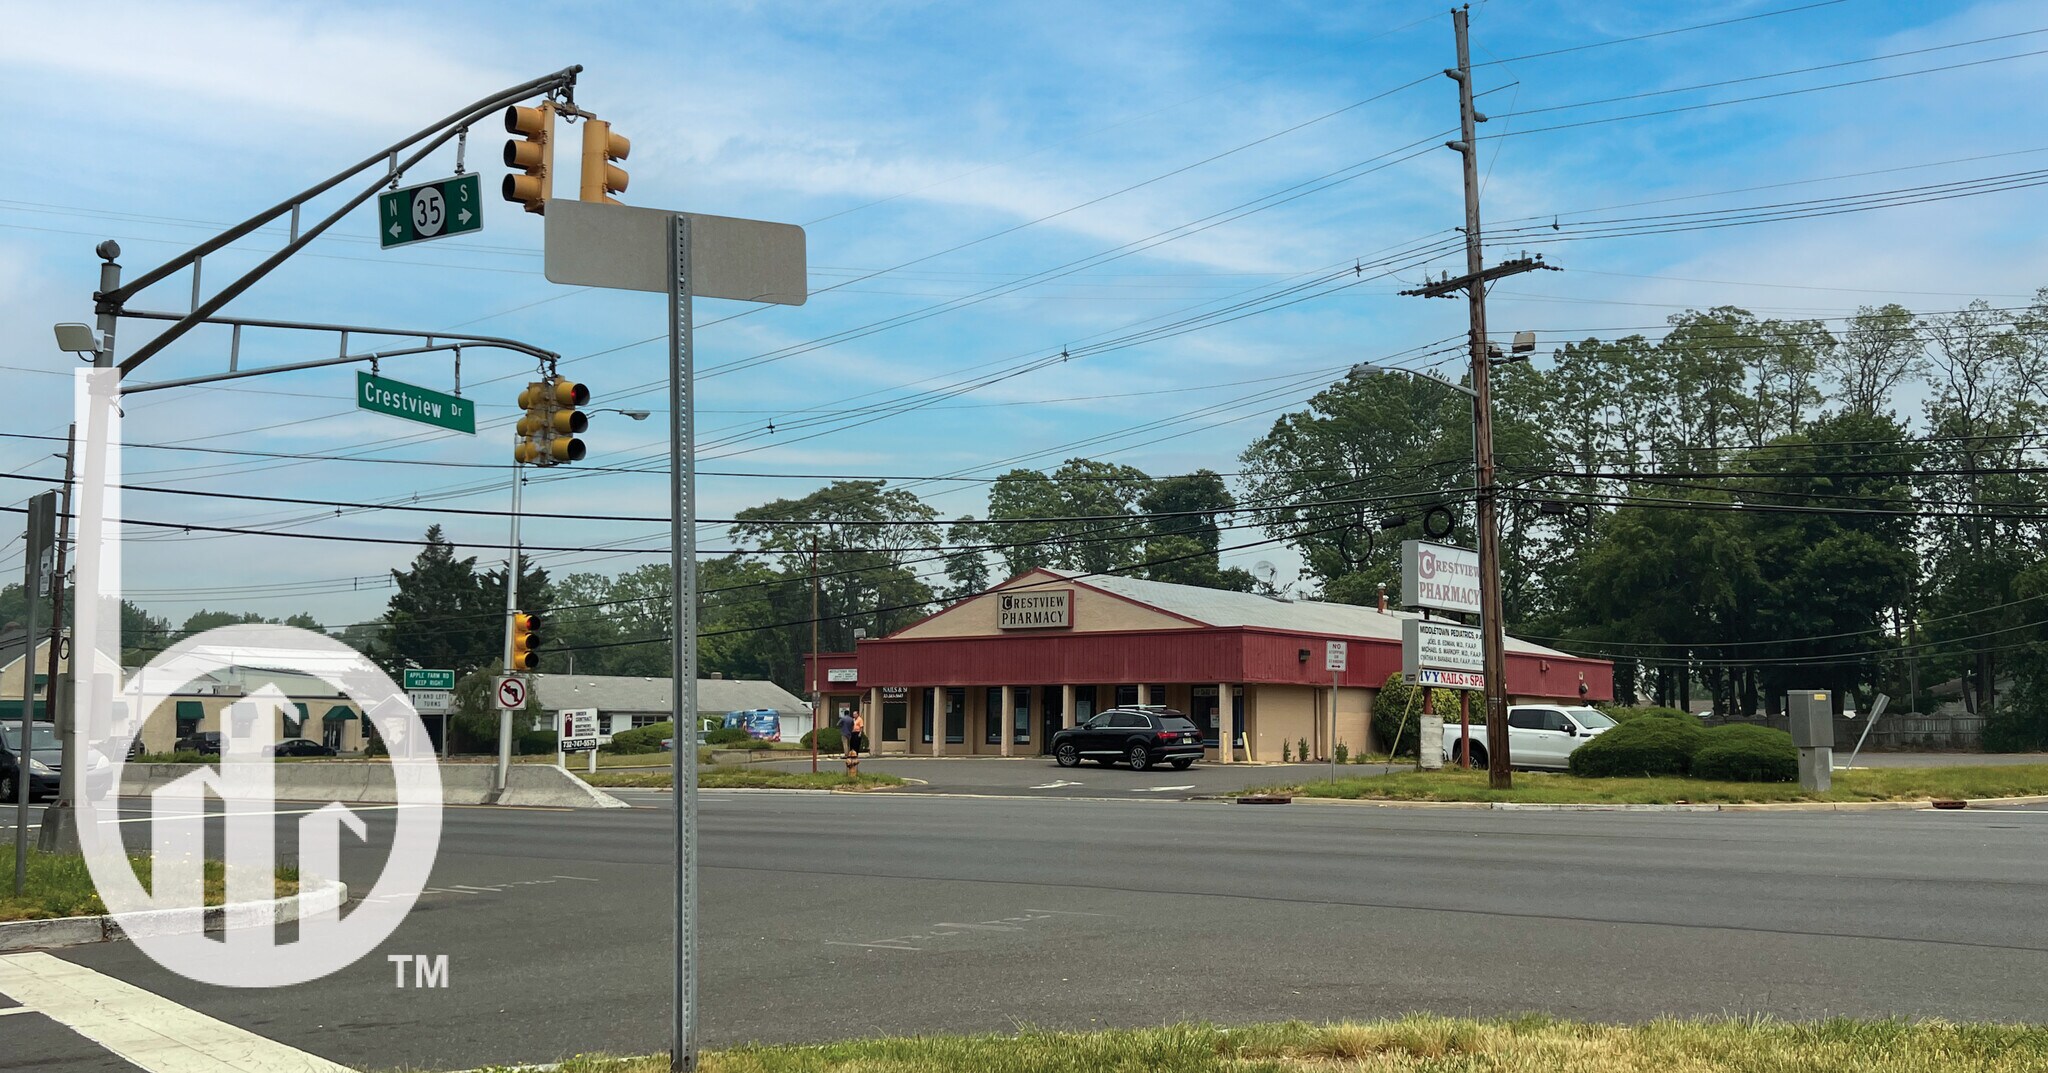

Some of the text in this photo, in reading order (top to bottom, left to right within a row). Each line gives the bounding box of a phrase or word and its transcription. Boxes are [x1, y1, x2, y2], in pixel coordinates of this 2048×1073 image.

[389, 184, 468, 227] N 35 S
[365, 382, 463, 418] Crestview Dr
[1420, 581, 1480, 605] PHARMACY
[1001, 595, 1065, 610] CRESTVIEW
[1002, 610, 1064, 625] PHARMACY
[1420, 627, 1449, 636] MIDDLETOWN
[1420, 671, 1439, 682] IVY
[1440, 672, 1464, 685] NAILS
[1470, 675, 1484, 686] SPA
